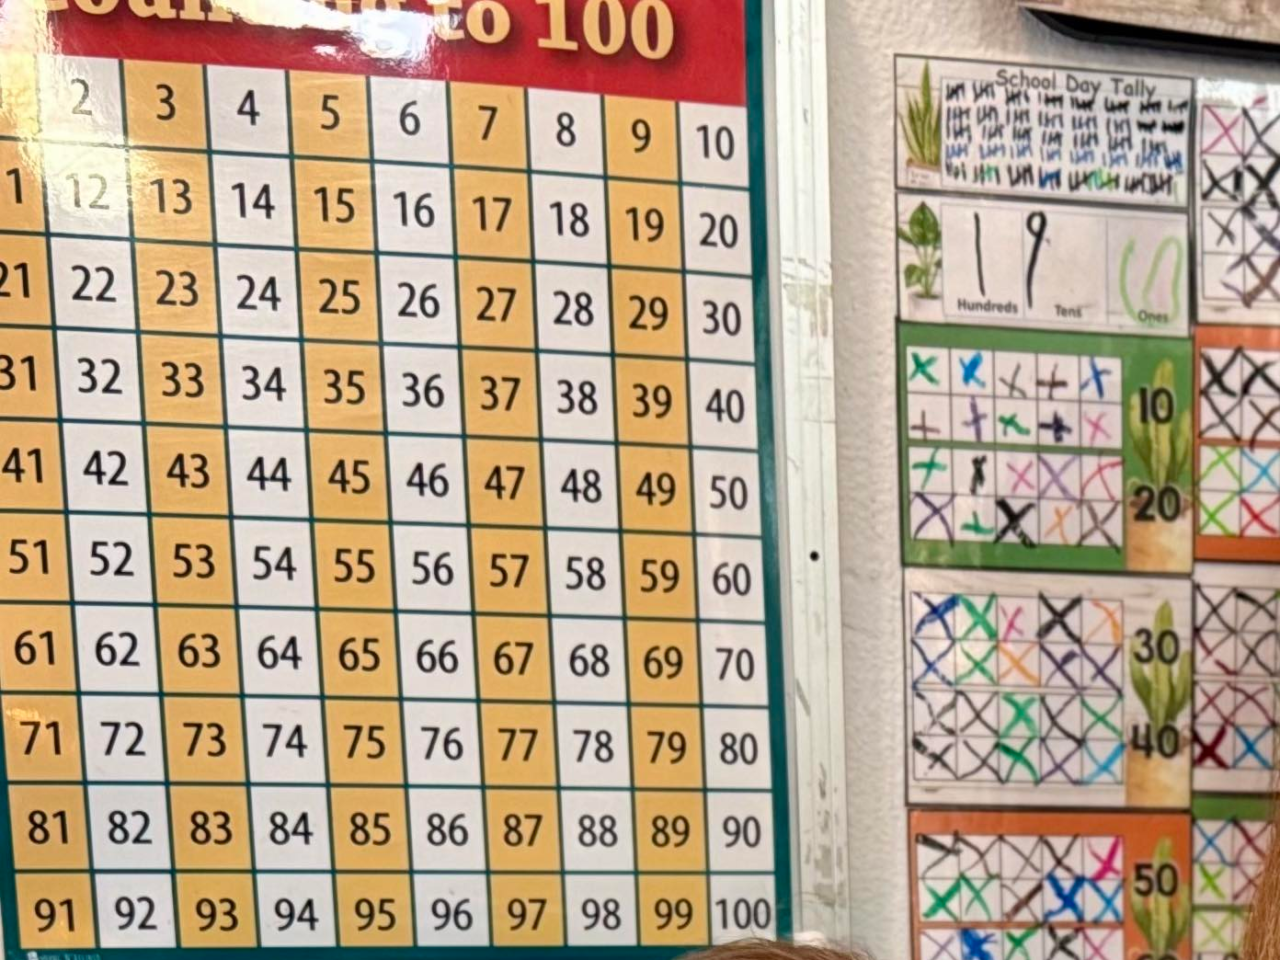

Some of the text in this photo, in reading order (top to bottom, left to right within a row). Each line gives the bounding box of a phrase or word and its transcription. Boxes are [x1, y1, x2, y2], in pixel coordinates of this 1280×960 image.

[535, 0, 674, 60] 100
[996, 69, 1157, 98] School Day Tally
[70, 77, 735, 161] 2 3 4 5 6 7 8 9 10
[150, 178, 739, 249] 13 14 15 16 17 18 19 20
[71, 264, 742, 337] 22 23 24 25 26 27 28 29 30
[957, 298, 1169, 323] Hundreds Tens Ones
[0, 354, 745, 424] 31 32 33 34 35 36 37 38 39 40
[1139, 388, 1173, 425] 10
[1133, 485, 1181, 523] 20
[9, 538, 752, 597] 51 52 53 54 55 56 57 58 59 60
[1133, 629, 1179, 664] 30
[20, 721, 759, 766] 71 72 73 74 75 76 77 78 79 80
[1131, 724, 1179, 758] 40
[28, 809, 761, 848] 81 82 83 84 85 86 87 88 89 90
[1133, 863, 1178, 897] 50
[34, 896, 772, 933] 91 92 93 94 95 96 97 98 99 100
